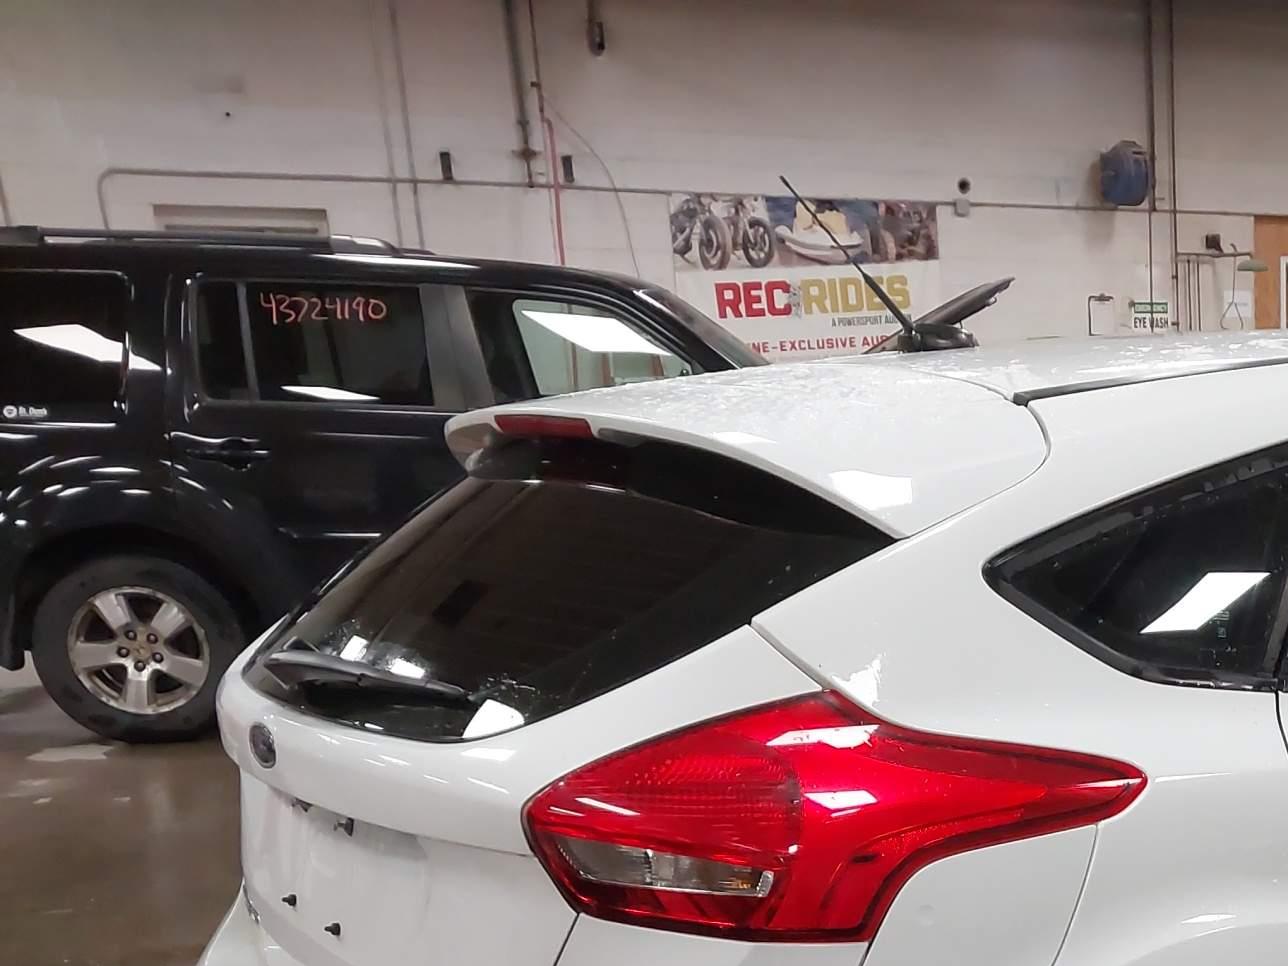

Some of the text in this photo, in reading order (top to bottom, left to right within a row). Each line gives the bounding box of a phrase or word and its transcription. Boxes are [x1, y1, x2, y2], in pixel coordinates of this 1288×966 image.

[715, 274, 911, 319] REC RIDES
[260, 291, 387, 325] 43724190
[838, 315, 882, 327] POWERSPORT
[1134, 317, 1147, 328] EYE
[752, 336, 856, 353] NE-EXCLUSIVE
